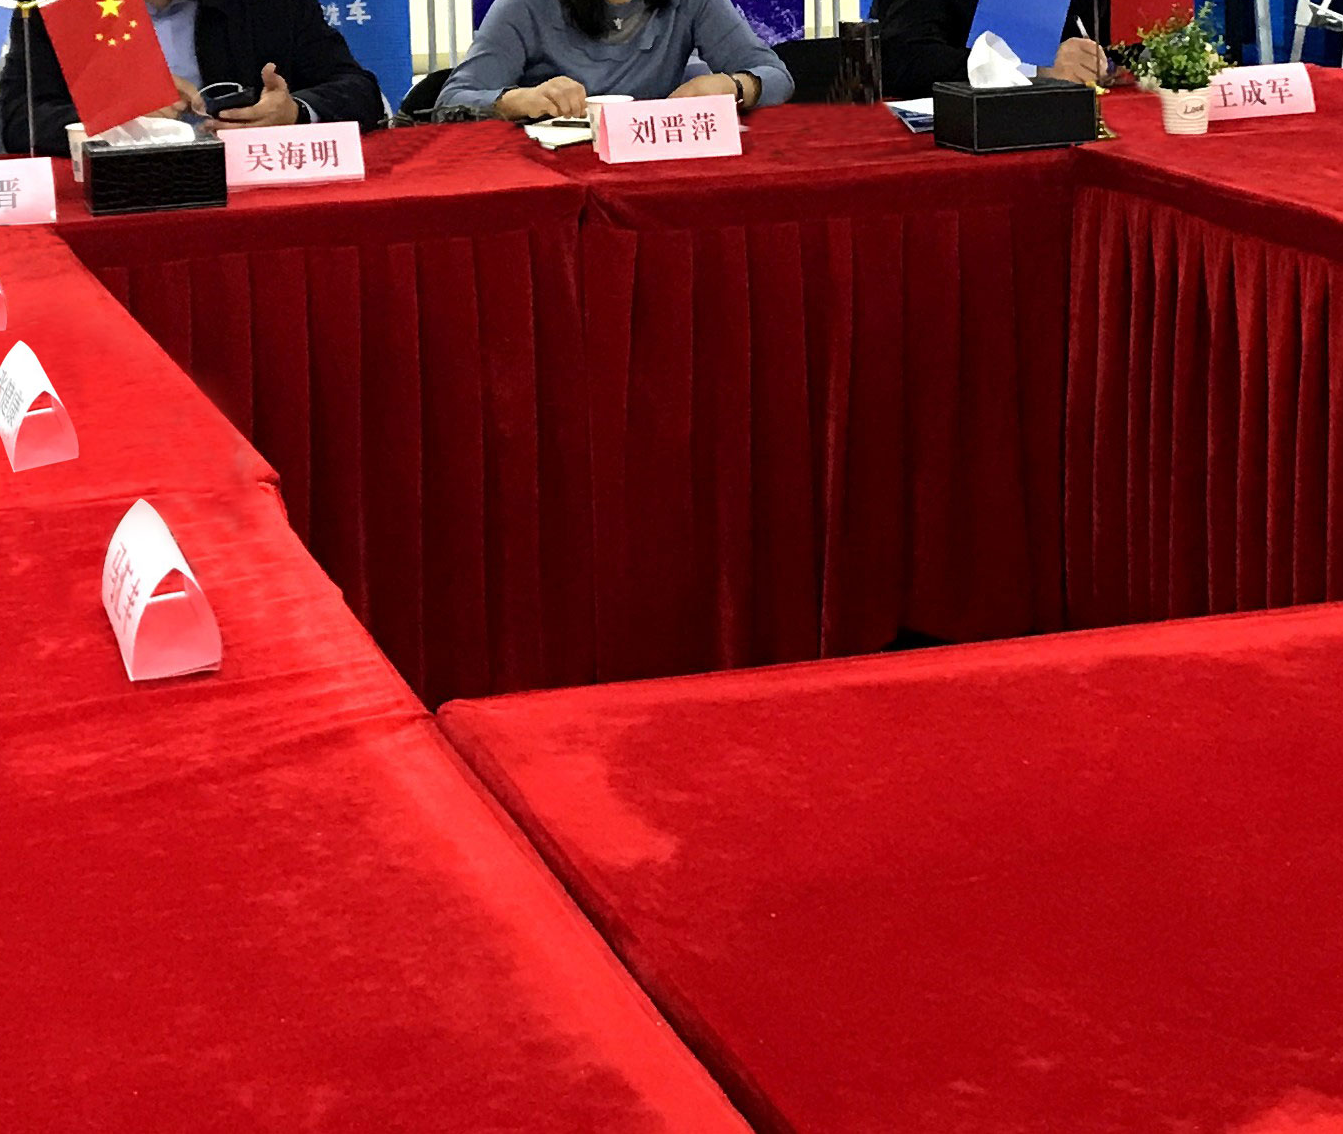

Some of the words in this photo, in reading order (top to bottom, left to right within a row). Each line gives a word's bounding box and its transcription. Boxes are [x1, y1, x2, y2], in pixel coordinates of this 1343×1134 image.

[1210, 77, 1294, 108] 王成军
[629, 111, 719, 147] 刘晋萍
[244, 138, 340, 174] 吴海明
